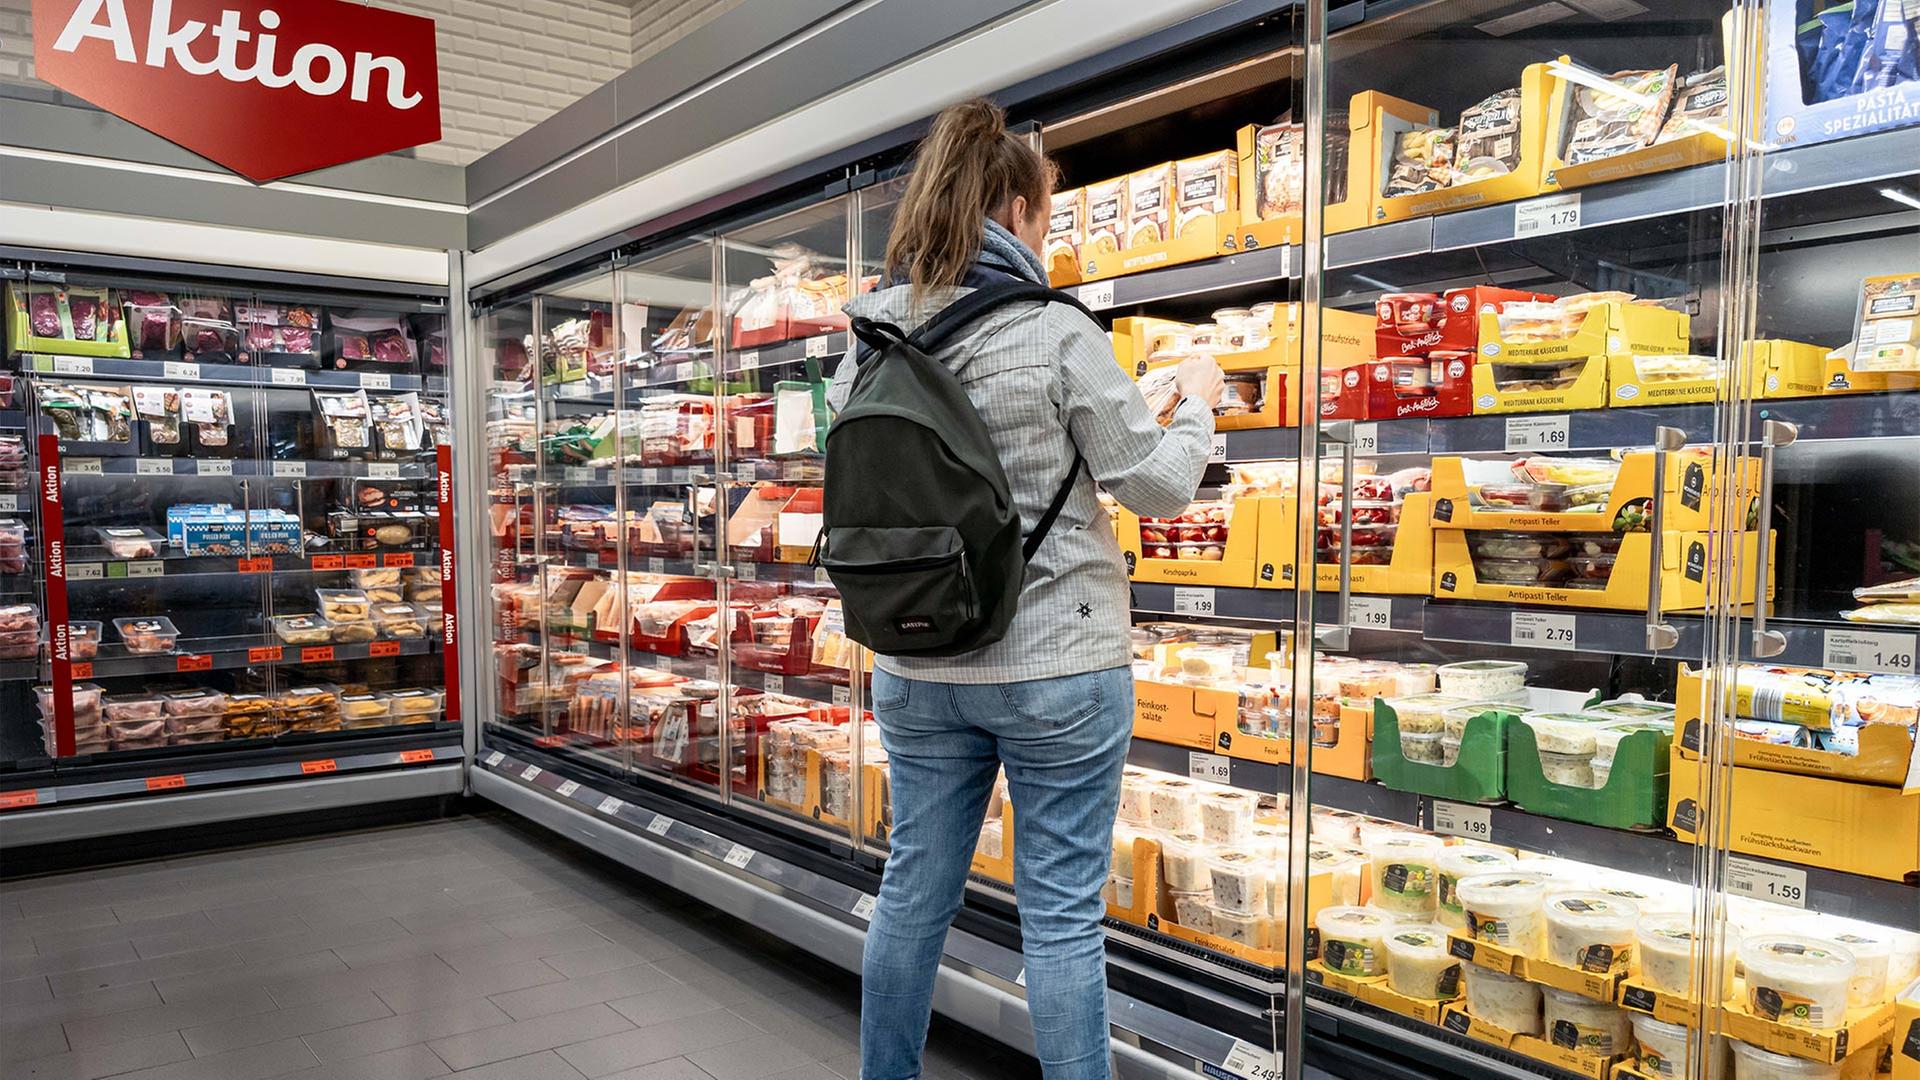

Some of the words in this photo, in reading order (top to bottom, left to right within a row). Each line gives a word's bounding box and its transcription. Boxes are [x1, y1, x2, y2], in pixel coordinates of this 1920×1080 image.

[53, 0, 423, 109] Aktion
[1857, 90, 1905, 113] PASTA
[1550, 210, 1577, 226] 1.79
[1321, 334, 1361, 347] rotaufstriche
[1539, 430, 1565, 443] 1.69
[1212, 445, 1225, 456] .29
[46, 465, 58, 503] Aktion
[440, 470, 450, 503] Aktion
[1509, 517, 1540, 526] Antipasti
[1541, 517, 1560, 526] Teller
[51, 540, 63, 578] Aktion
[442, 548, 452, 581] Aktion
[1508, 590, 1544, 600] Antipasti
[1545, 592, 1568, 602] Teller
[1194, 601, 1212, 611] 1.99
[1365, 612, 1387, 624] 1.99
[445, 612, 454, 645] Aktion
[1546, 628, 1573, 641] 2.79
[55, 623, 67, 661] Aktion
[1874, 652, 1911, 668] 1.49
[1137, 698, 1169, 712] Feinkost-
[1142, 711, 1163, 723] salate
[1211, 766, 1228, 777] 1.69
[1463, 820, 1486, 834] 1.99
[1740, 835, 1822, 856] Frühstücksbackwaren
[1767, 882, 1801, 900] 1.59
[1251, 1064, 1275, 1080] 2.49
